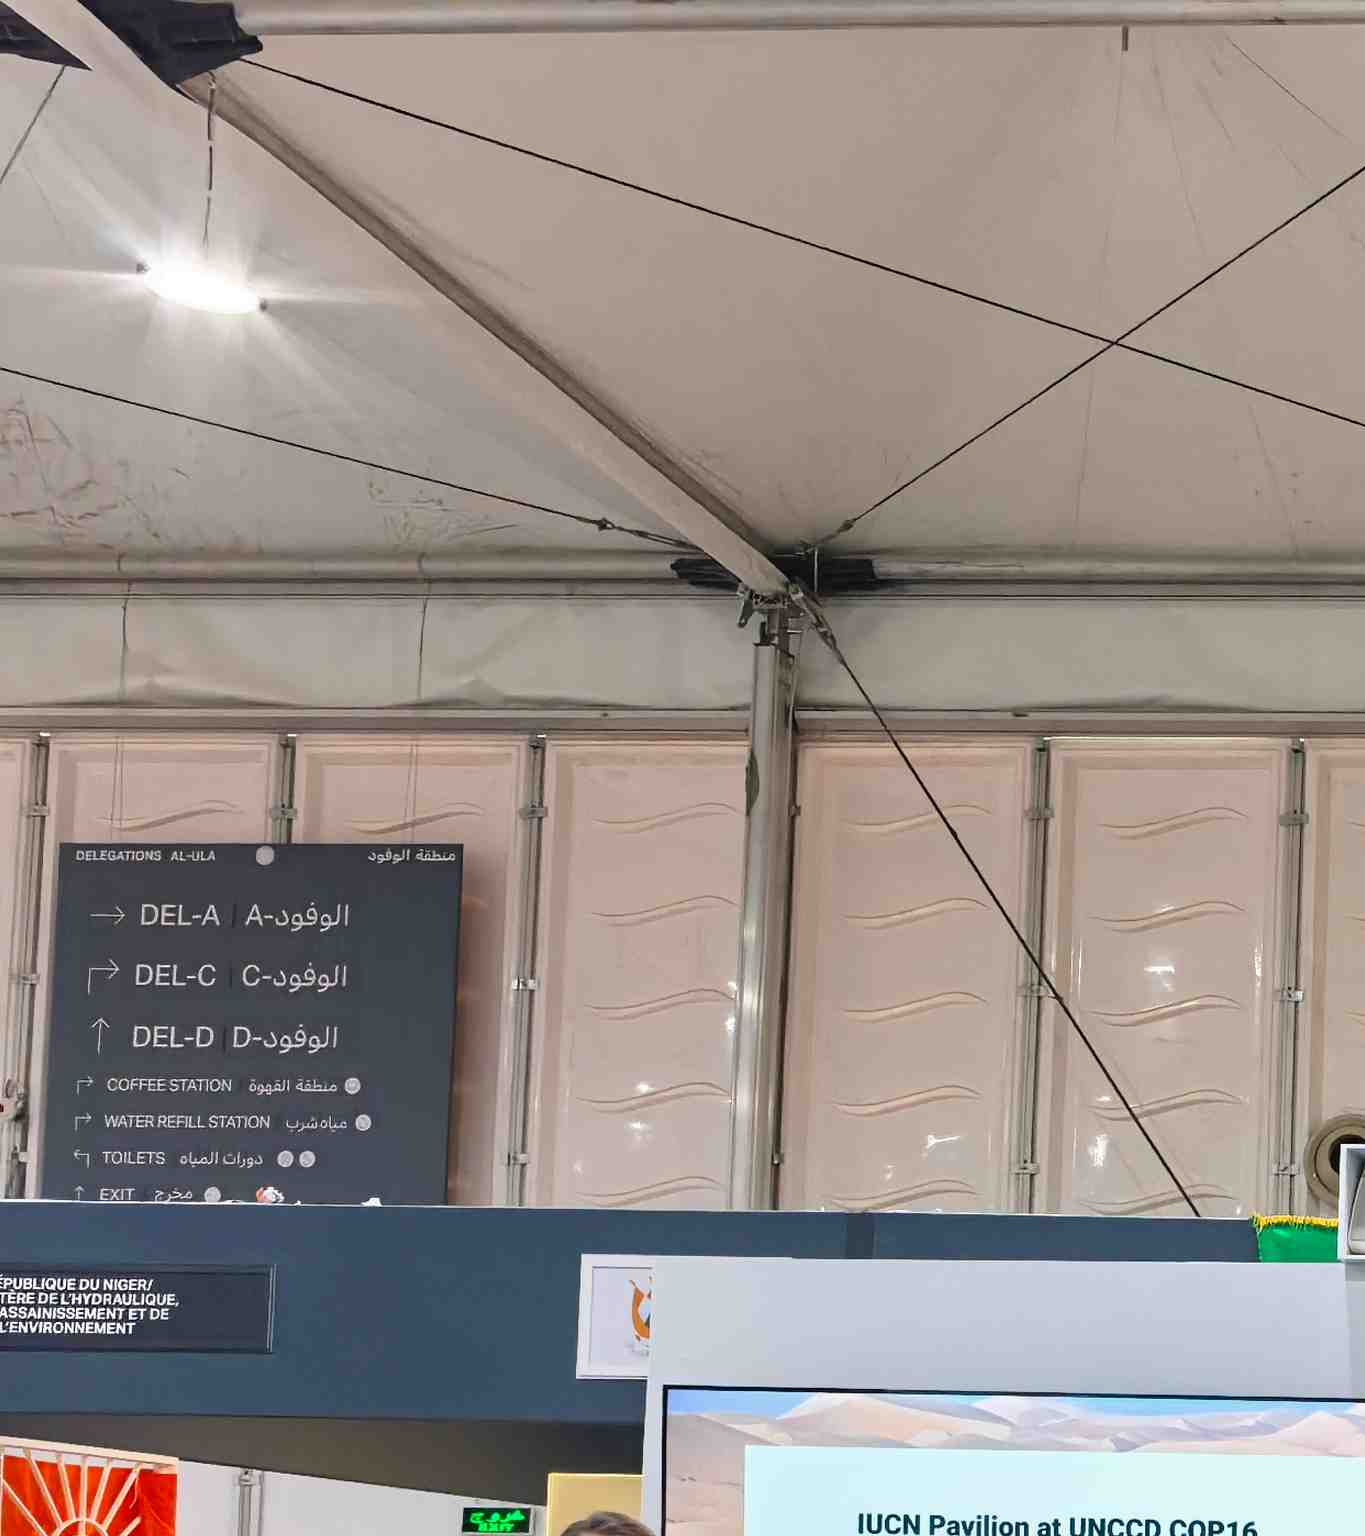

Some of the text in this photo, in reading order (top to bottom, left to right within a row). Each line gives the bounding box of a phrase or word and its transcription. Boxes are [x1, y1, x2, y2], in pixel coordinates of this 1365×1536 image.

[76, 850, 216, 862] DELEGATIONS AL-ULA
[368, 849, 456, 864] منطقة الوفود
[140, 904, 220, 926] DEL-A
[135, 964, 217, 987] DEL-C
[132, 1026, 215, 1048] DEL-D
[107, 1078, 232, 1092] COFFEE STATION
[104, 1115, 271, 1129] WATER REFILL STATION
[102, 1151, 166, 1165] TOILETS
[100, 1188, 136, 1201] EXIT
[79, 1278, 100, 1290] DU
[38, 1292, 59, 1305] DE
[0, 1306, 169, 1320] ASSAINISSEMENT ET DE
[857, 1513, 922, 1535] IUCN
